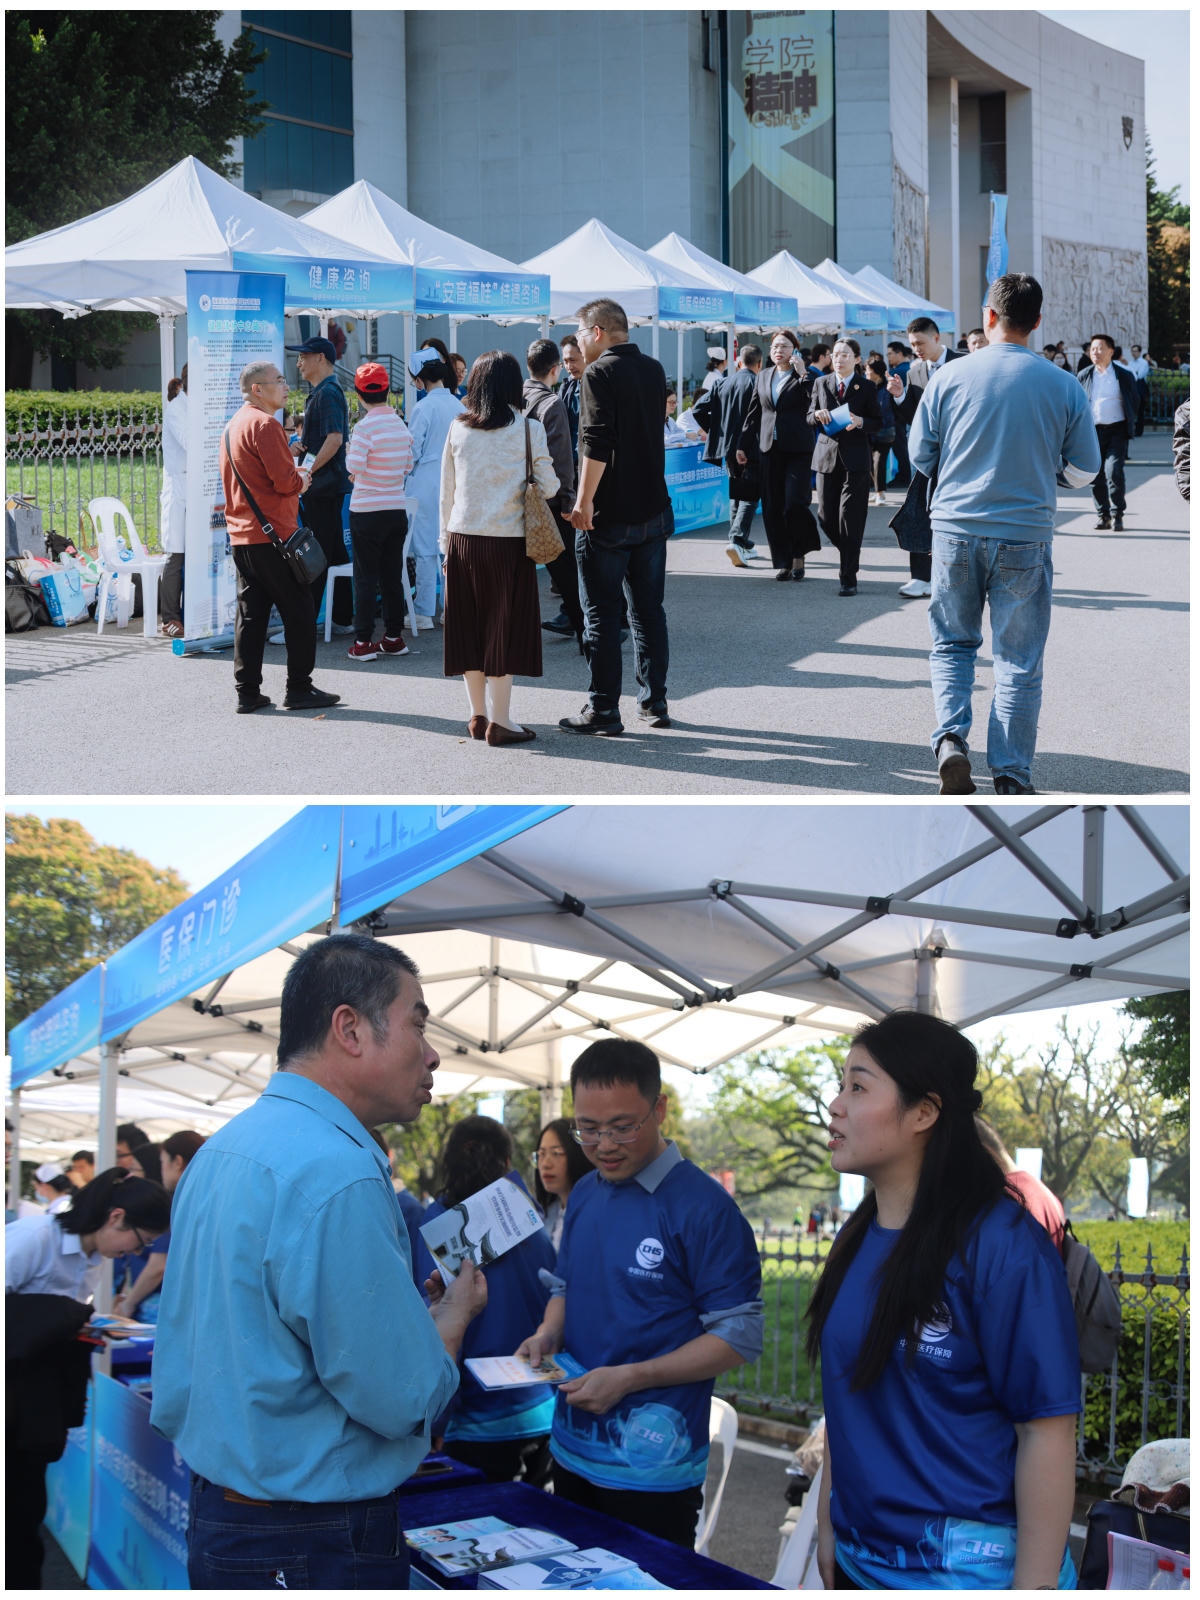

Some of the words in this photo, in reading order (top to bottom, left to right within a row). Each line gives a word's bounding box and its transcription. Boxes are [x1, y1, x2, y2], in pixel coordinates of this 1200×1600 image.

[745, 35, 816, 73] 学院
[744, 69, 818, 119] 精神
[308, 265, 371, 292] 健康咨询
[158, 878, 241, 975] 医保门诊
[900, 1338, 953, 1359] 中医疗保障
[960, 1539, 1006, 1559] CHS
